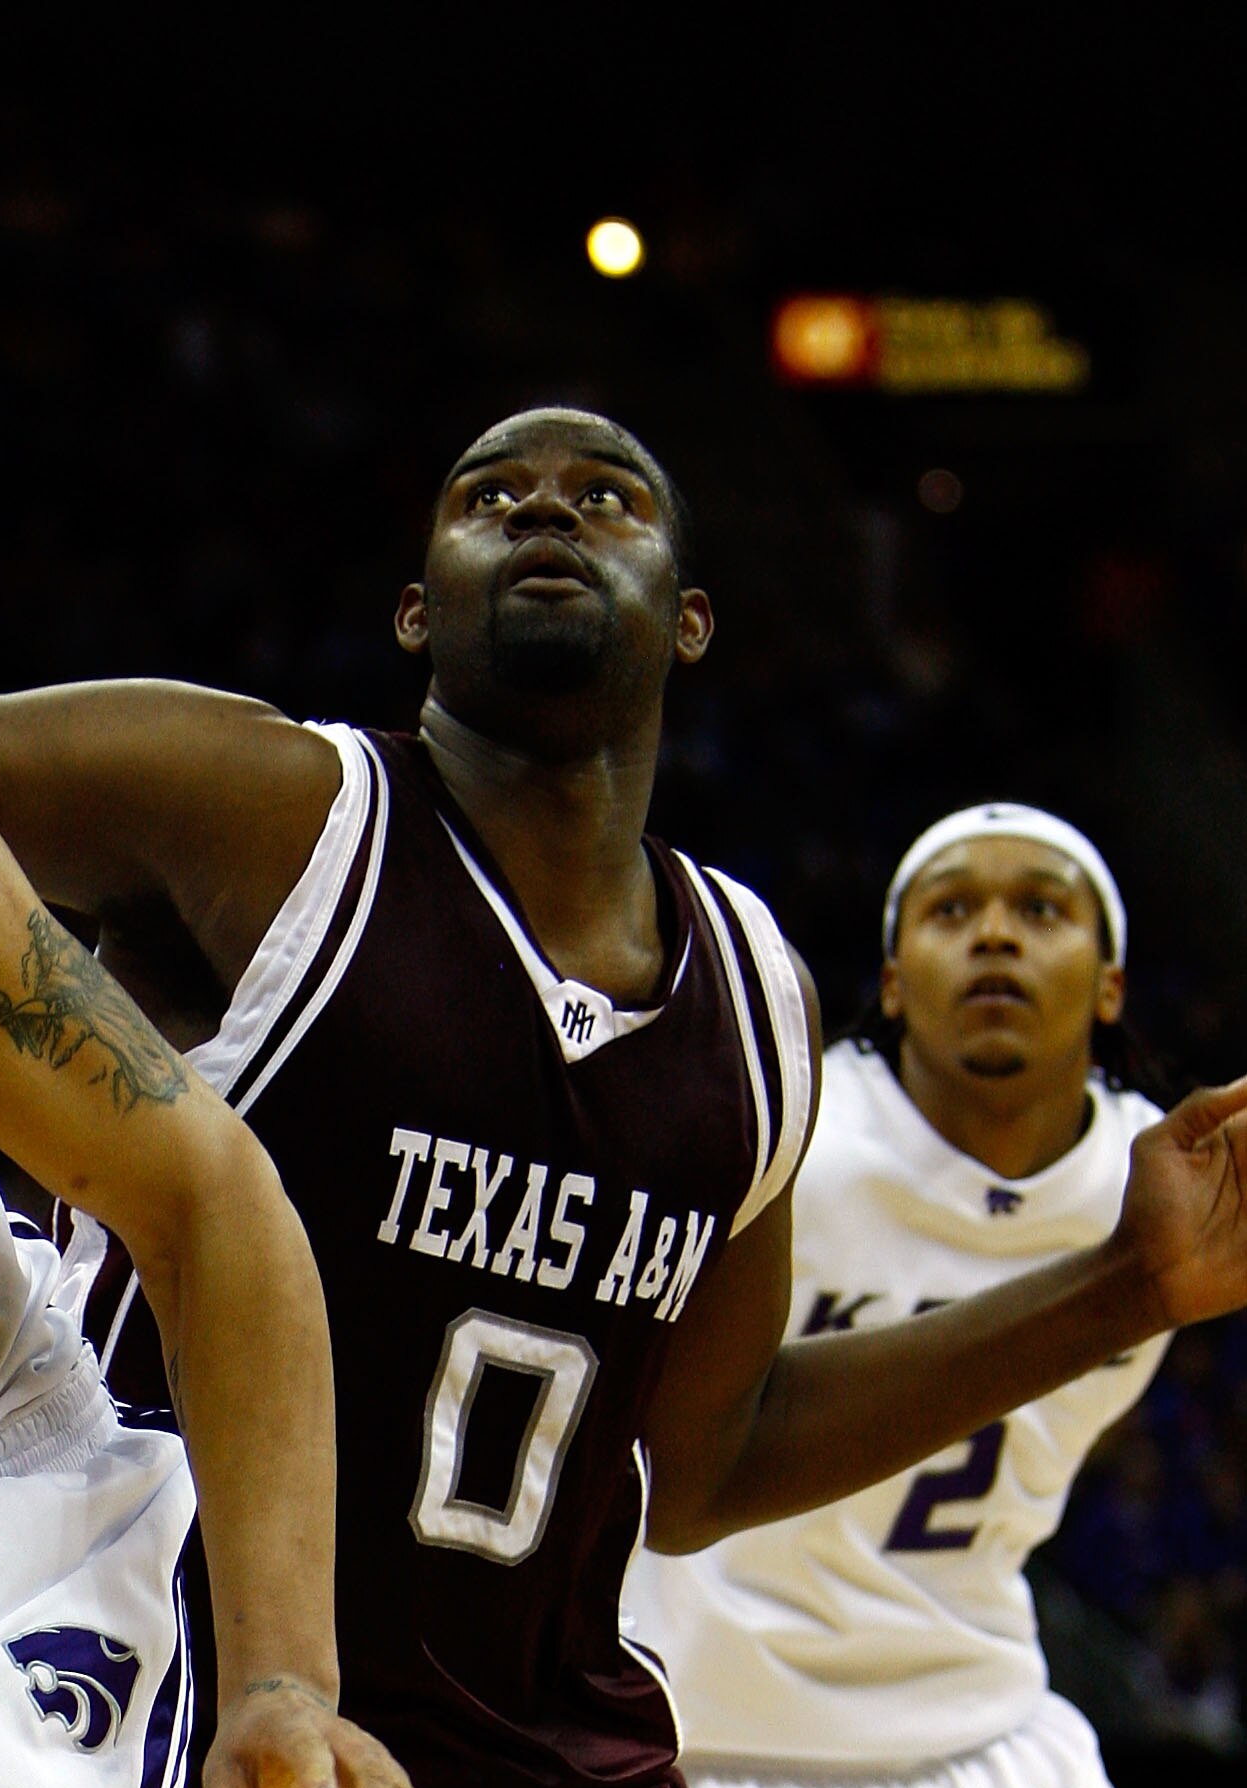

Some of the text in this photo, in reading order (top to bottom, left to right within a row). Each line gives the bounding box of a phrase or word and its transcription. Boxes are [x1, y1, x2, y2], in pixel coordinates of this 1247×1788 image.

[377, 1127, 716, 1323] TEXAS A&M
[407, 1306, 601, 1567] 0
[884, 1418, 1008, 1553] 2
